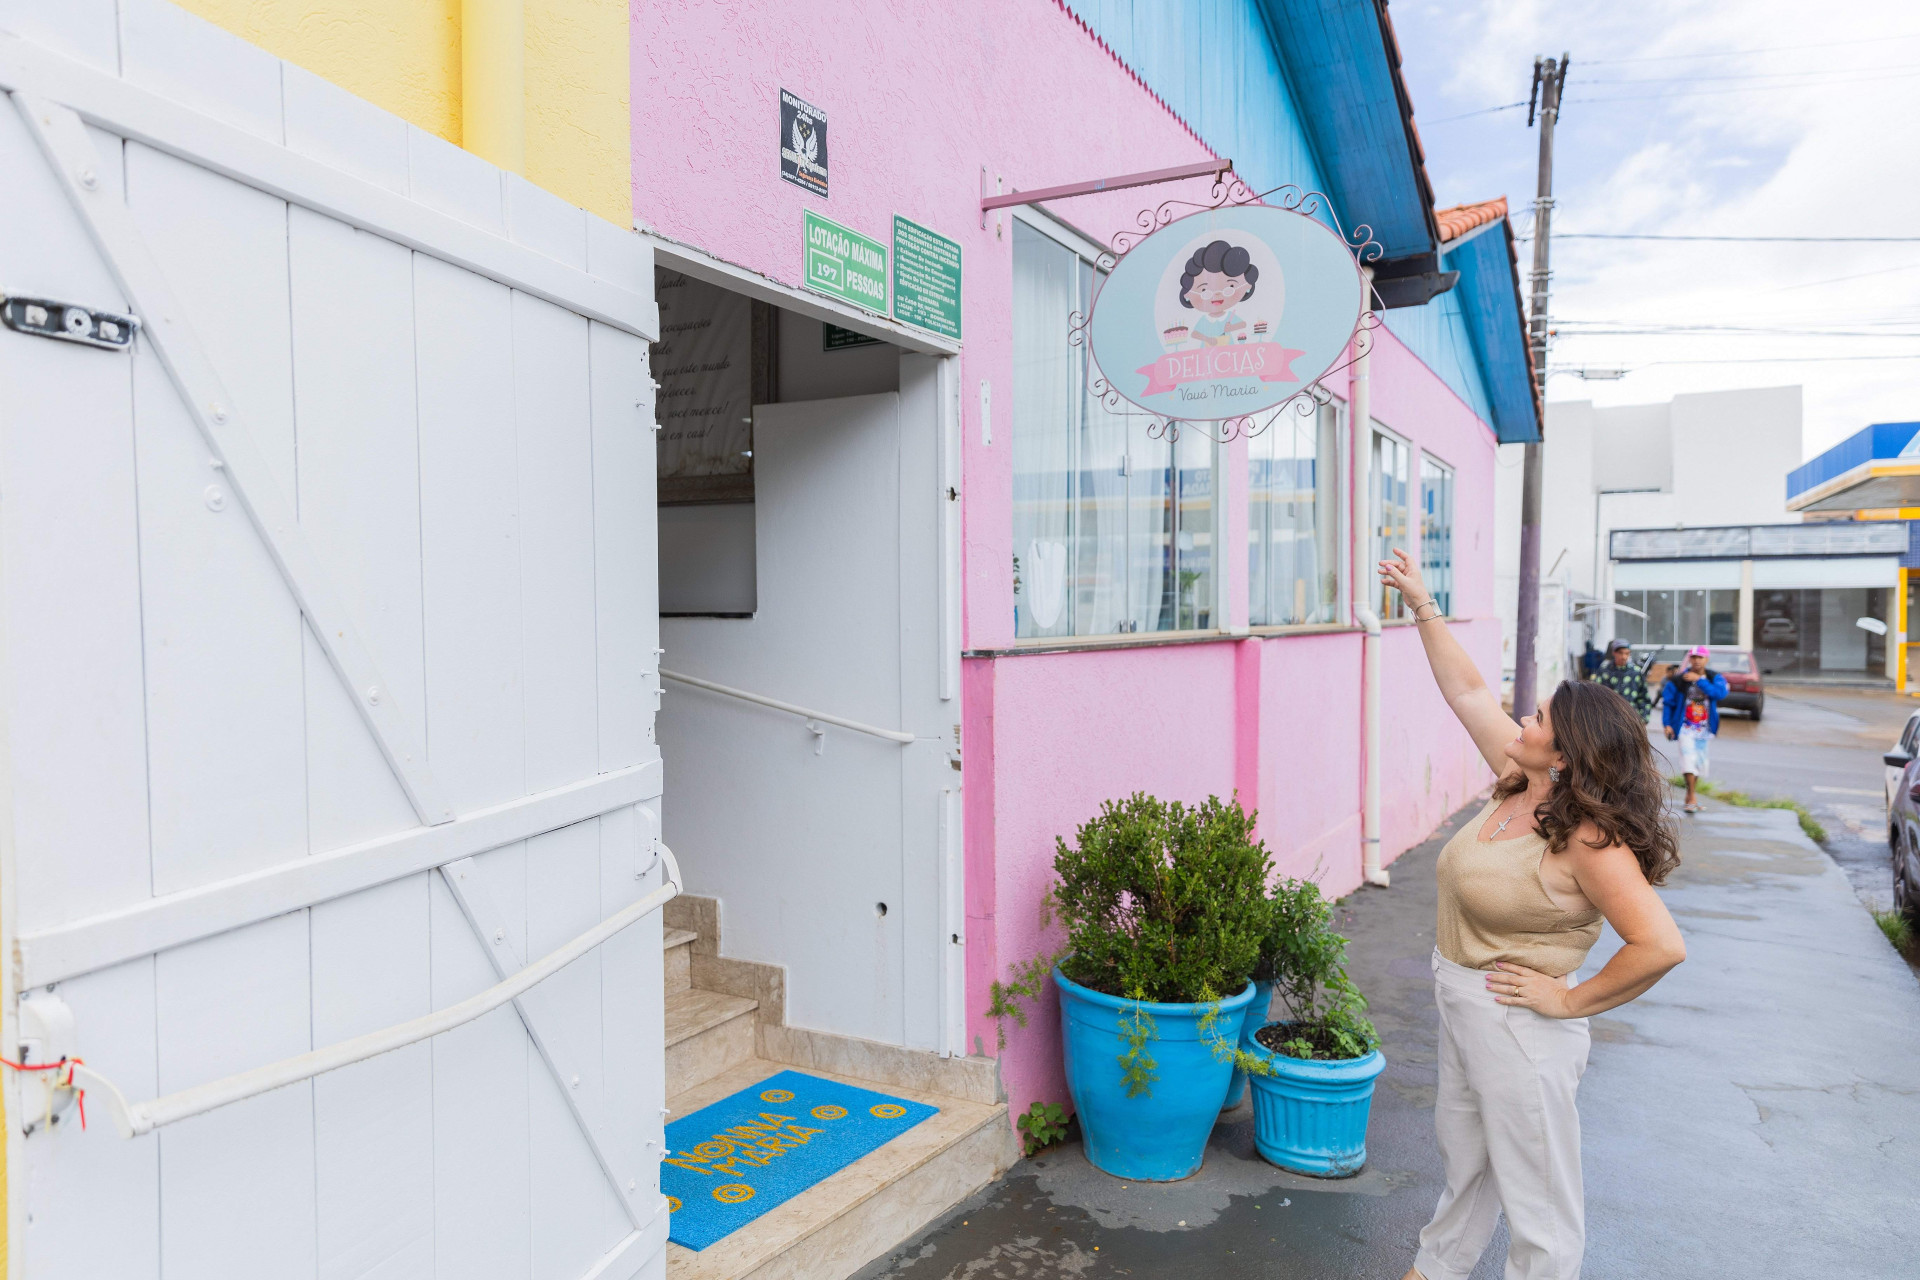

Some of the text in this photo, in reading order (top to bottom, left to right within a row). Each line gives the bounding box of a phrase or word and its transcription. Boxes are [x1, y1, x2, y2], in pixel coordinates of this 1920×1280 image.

[782, 91, 827, 123] MONITORADO
[796, 110, 813, 125] 24hs
[809, 223, 884, 273] LOTAÇÃO MÁXIMA
[817, 262, 838, 281] 197
[846, 269, 884, 301] PESSOAS
[1166, 346, 1266, 379] DELÍCIAS
[1210, 383, 1259, 398] Maria
[664, 1112, 797, 1175] NONNA
[711, 1124, 826, 1177] MARIA
